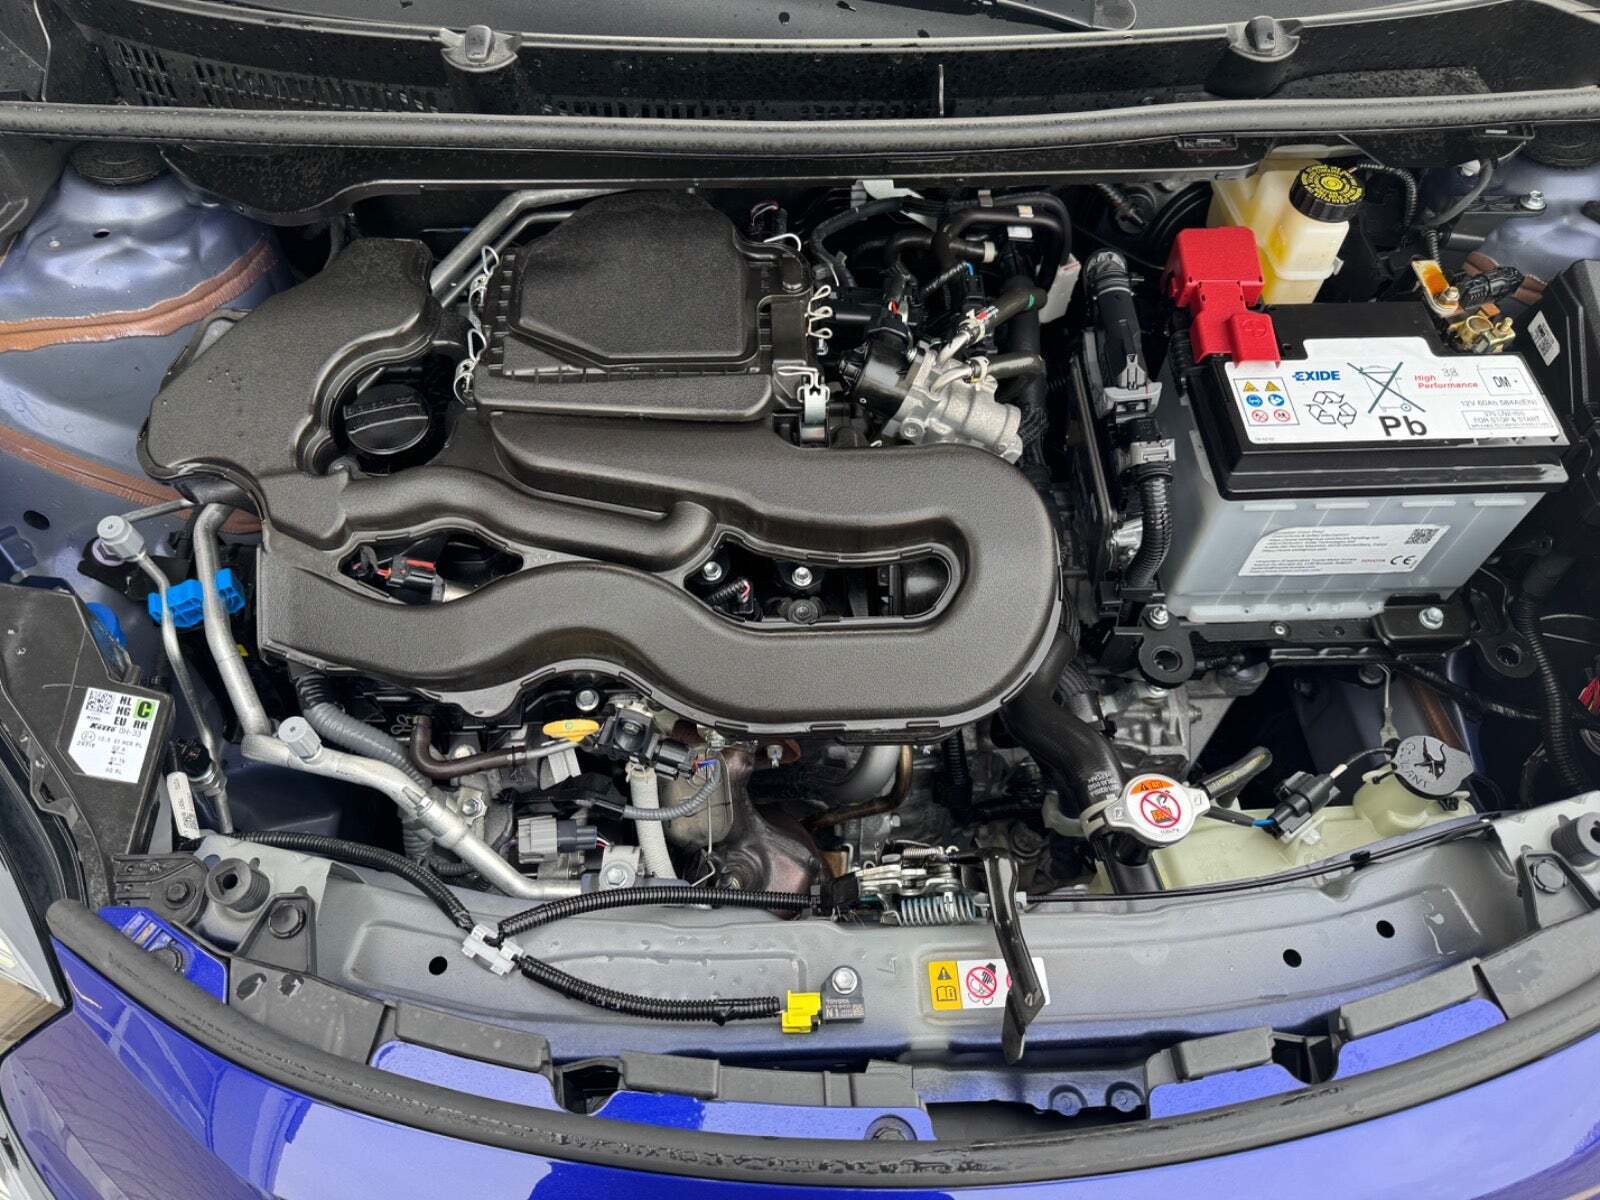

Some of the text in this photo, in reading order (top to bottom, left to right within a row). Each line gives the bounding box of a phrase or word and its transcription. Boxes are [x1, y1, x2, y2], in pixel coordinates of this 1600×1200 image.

[1293, 370, 1341, 381] EXIDE
[1379, 415, 1427, 437] Pb
[137, 701, 152, 718] C
[113, 716, 127, 726] EU
